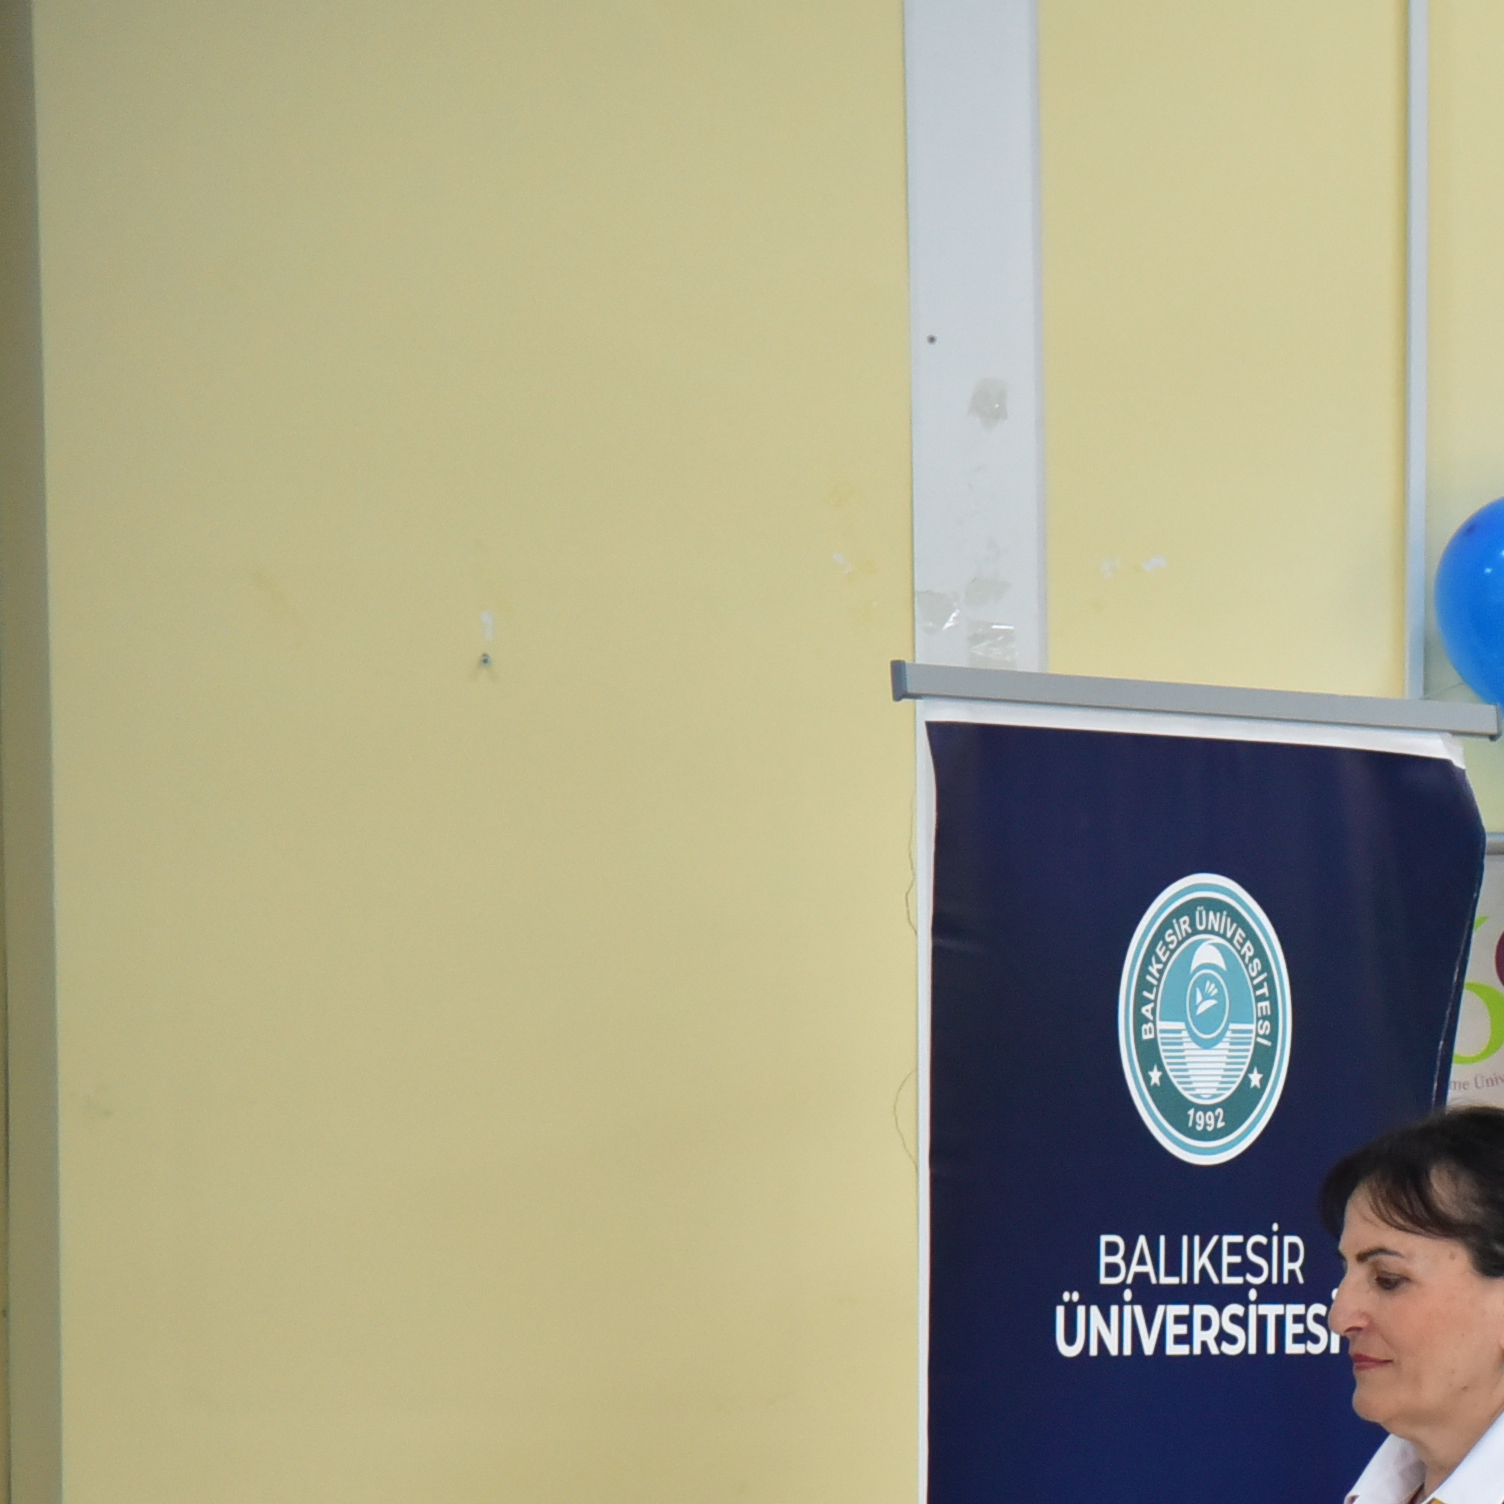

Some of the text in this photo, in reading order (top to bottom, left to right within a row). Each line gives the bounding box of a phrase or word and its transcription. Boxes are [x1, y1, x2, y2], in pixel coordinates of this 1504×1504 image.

[1141, 914, 1192, 1040] BALIKESİR
[1187, 1107, 1225, 1132] 1992
[1099, 1222, 1305, 1285] BALIKESİR
[1055, 1288, 1341, 1358] ÜNİVERSİTESİ
